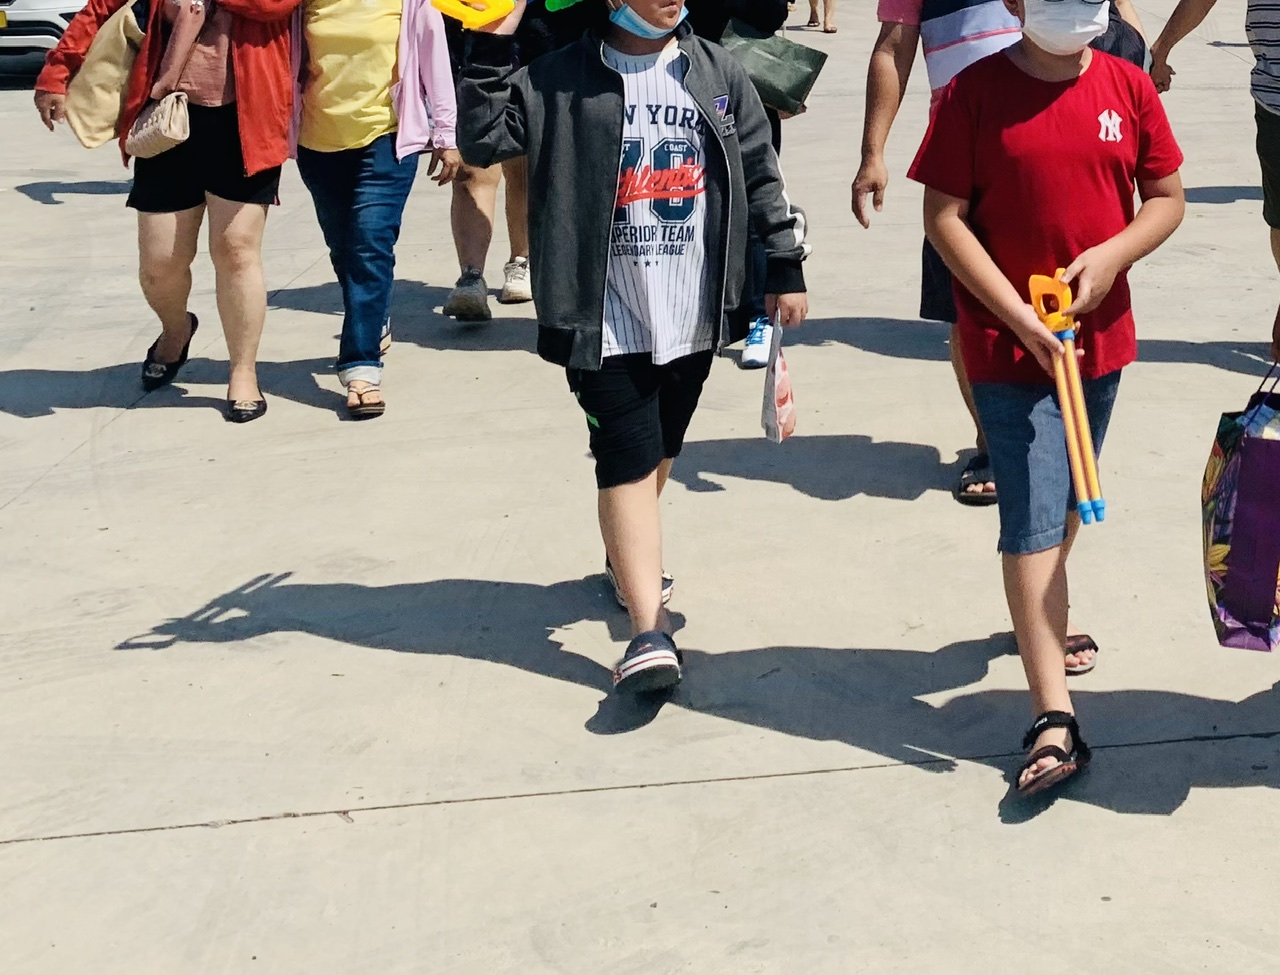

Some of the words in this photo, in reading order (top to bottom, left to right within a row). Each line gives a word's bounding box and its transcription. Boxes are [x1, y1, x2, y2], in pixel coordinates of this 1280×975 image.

[664, 144, 688, 152] COAST
[611, 225, 657, 243] UPERIOR
[660, 225, 695, 242] TEAM
[655, 244, 686, 256] LEAGUE
